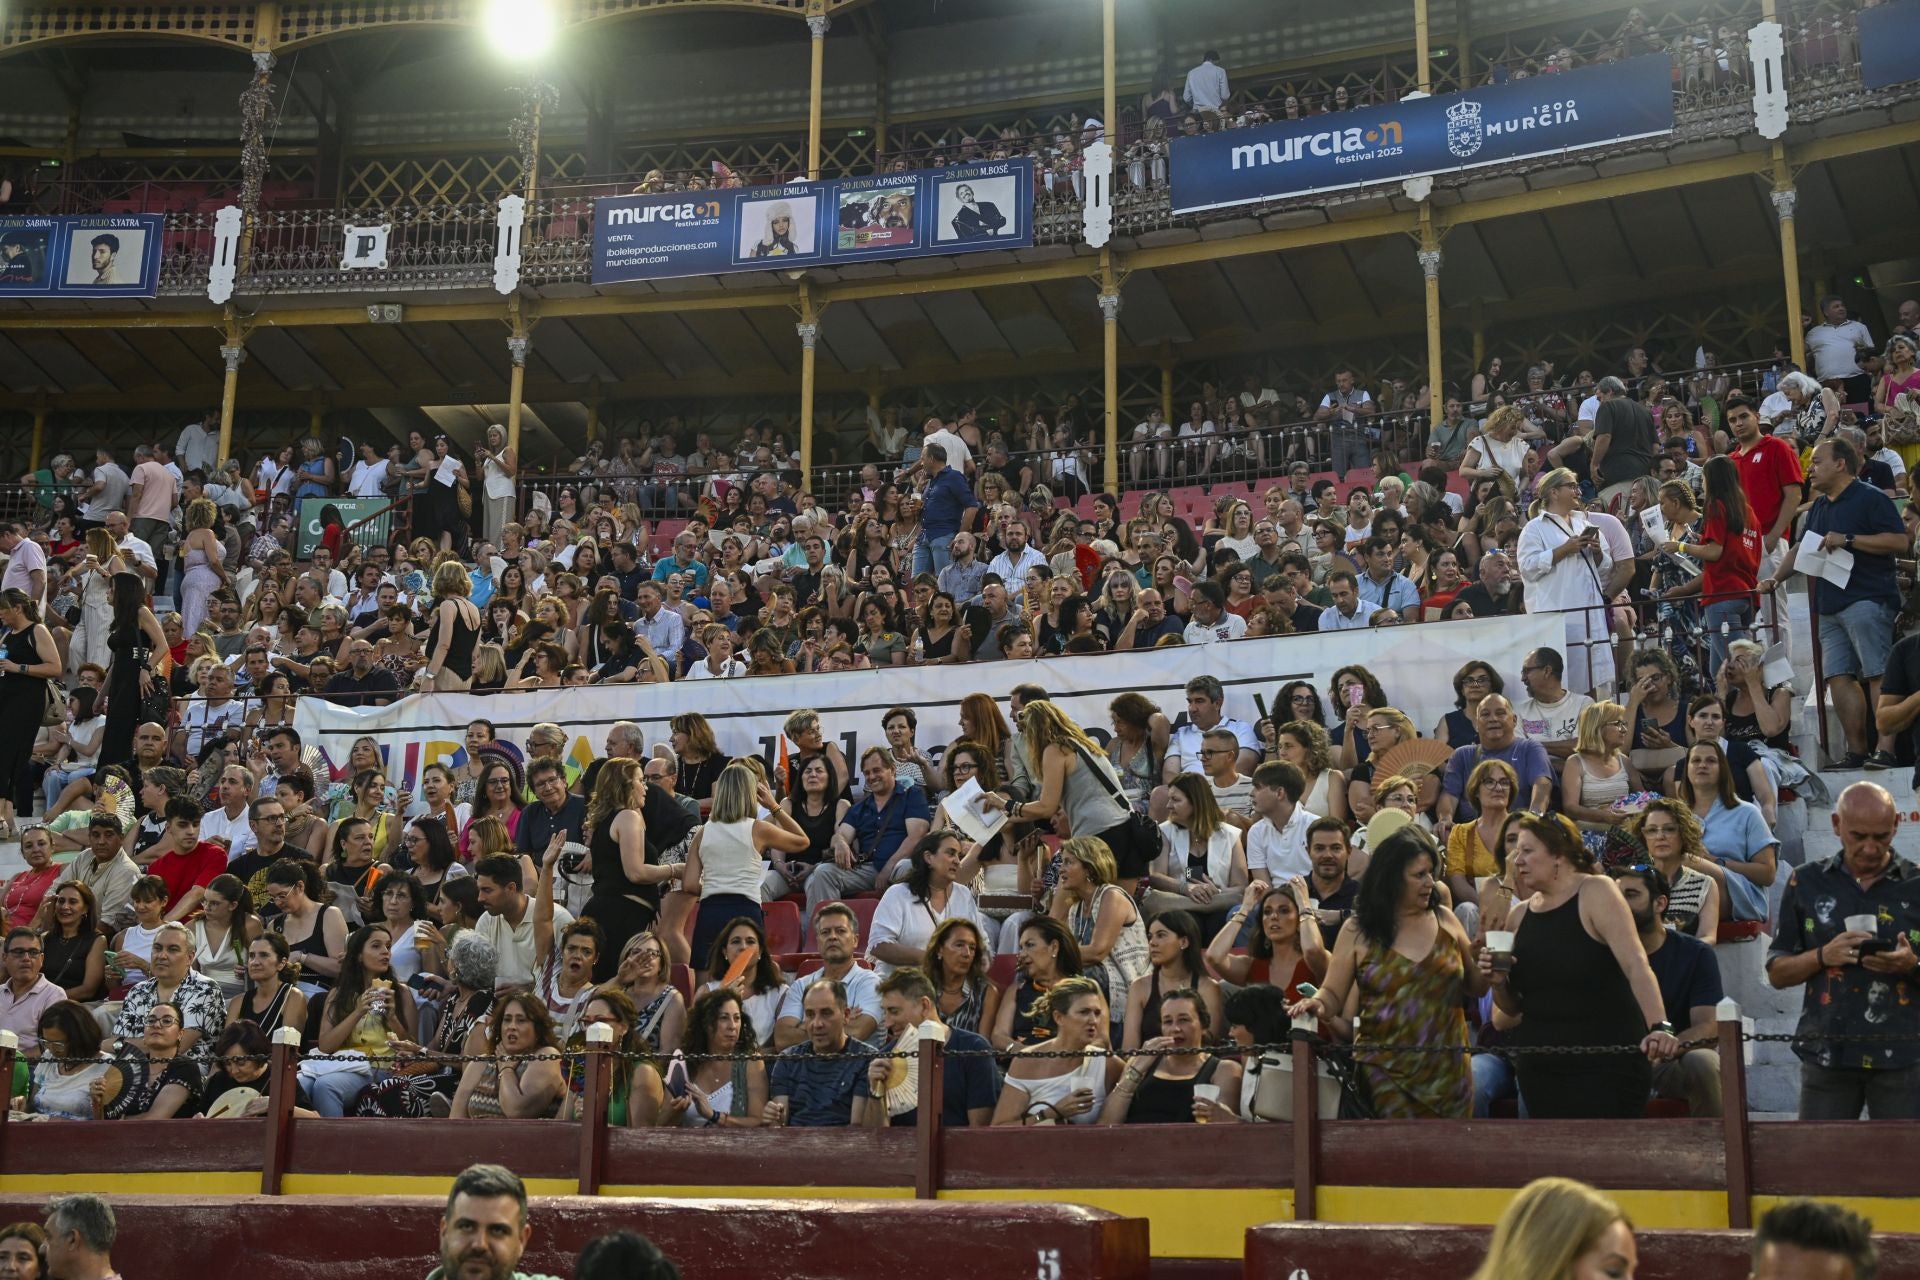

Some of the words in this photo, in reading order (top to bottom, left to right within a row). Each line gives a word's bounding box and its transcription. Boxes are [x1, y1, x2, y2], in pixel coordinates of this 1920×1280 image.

[1532, 99, 1576, 115] 1200
[1486, 108, 1580, 137] MURCIA
[1334, 151, 1375, 165] festival
[1377, 146, 1403, 159] 2025
[945, 170, 955, 180] 28
[956, 168, 979, 179] JUNIO
[980, 163, 1009, 176] M.BOSÉ
[841, 182, 851, 191] 20
[852, 180, 874, 190] JUNIO
[876, 174, 918, 188] A.PARSONS
[751, 190, 758, 199] 15
[759, 189, 782, 199] JUNIO
[783, 185, 809, 196] EMILIA
[4, 218, 25, 228] JUNIO
[25, 218, 52, 228] SABINA
[80, 218, 88, 227] 12
[88, 218, 110, 227] JULIO
[110, 218, 140, 227] S.YATRA
[675, 219, 701, 228] festival
[702, 218, 720, 226] 2025
[355, 235, 376, 258] P
[605, 255, 669, 268] murciaon.com
